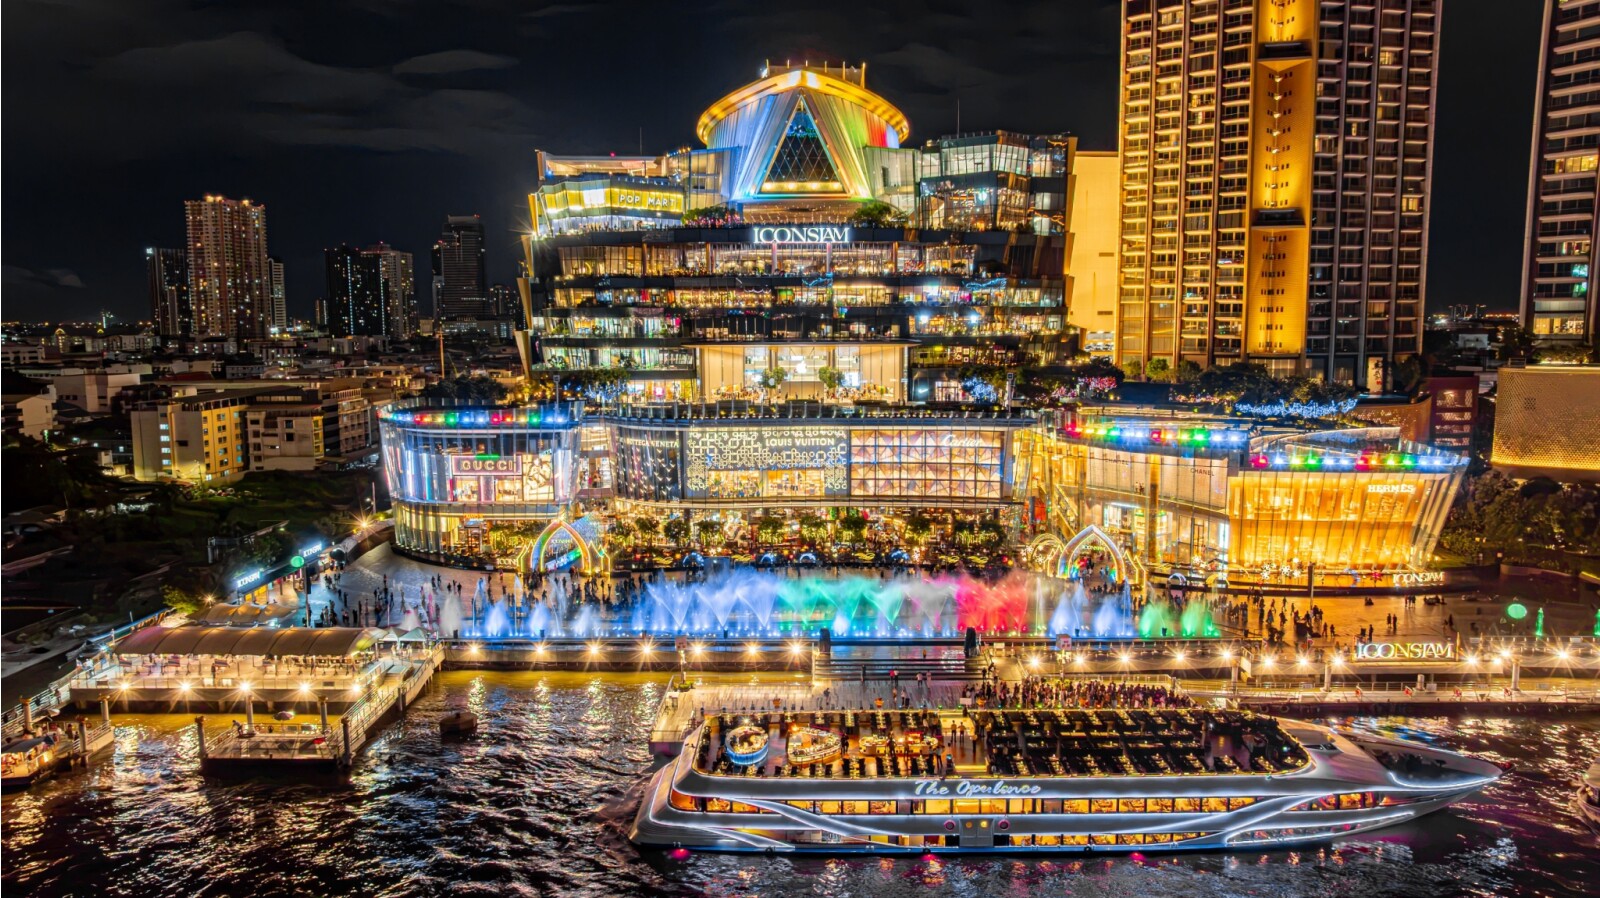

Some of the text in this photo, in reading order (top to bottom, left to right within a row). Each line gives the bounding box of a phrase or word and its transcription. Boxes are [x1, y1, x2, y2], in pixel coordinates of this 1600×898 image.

[620, 194, 675, 207] POP MART
[753, 227, 850, 244] ICONSIAM
[651, 440, 679, 448] VENETA
[765, 438, 834, 447] LOUIS VUITTON
[941, 434, 981, 447] Cartier
[462, 460, 513, 471] GUCCI
[1190, 467, 1215, 477] CHANEL
[1392, 571, 1445, 583] ICONSIAM
[1357, 643, 1454, 659] ICONSIAM
[914, 780, 949, 795] The
